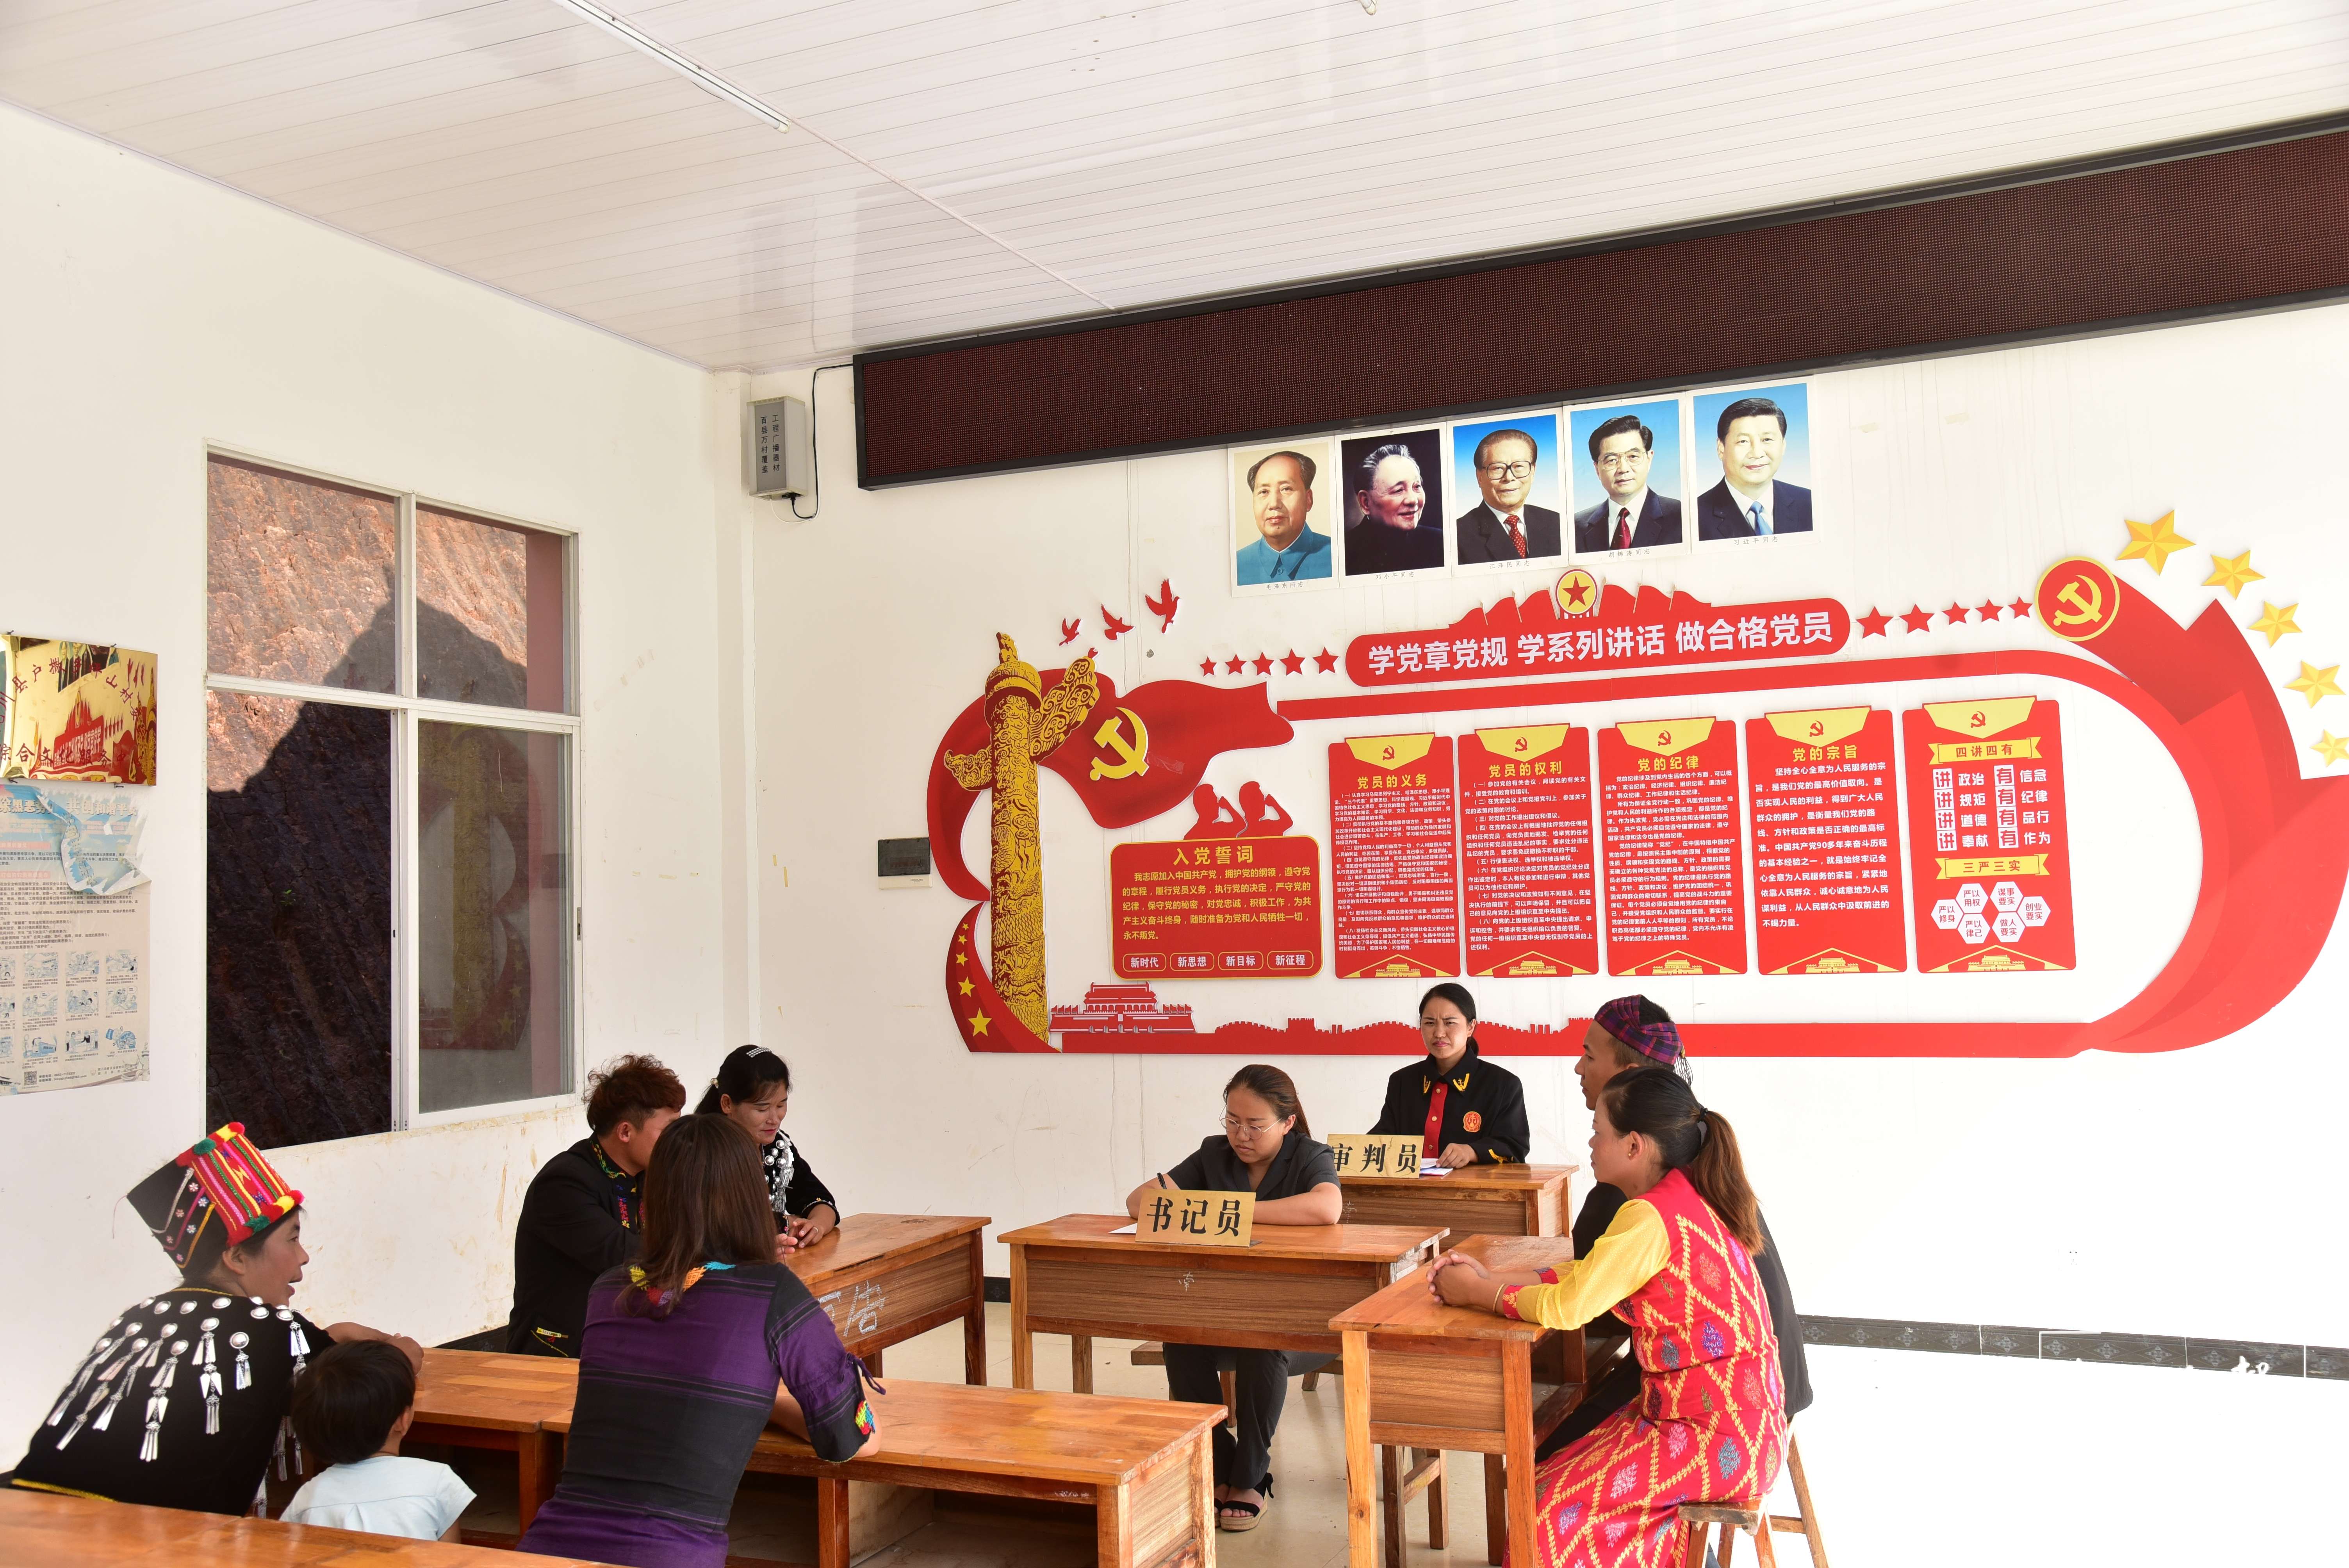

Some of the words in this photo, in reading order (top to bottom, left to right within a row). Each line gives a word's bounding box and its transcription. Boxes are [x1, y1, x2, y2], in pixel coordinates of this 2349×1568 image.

[1734, 536, 1778, 545] 习近平同志
[1609, 549, 1650, 558] 胡锦涛同志
[1489, 561, 1530, 569] 江泽民同志
[1375, 571, 1415, 581] 邓小平同志
[1266, 582, 1304, 590] 毛泽东同志
[1369, 637, 1507, 675] 学党章党规
[1518, 625, 1665, 665] 学系列讲话
[1675, 613, 1833, 652] 做合格党员
[1793, 743, 1857, 762] 党的宗旨
[1956, 744, 2013, 757] 四讲四有
[1489, 760, 1564, 779] 党员的权利
[1638, 754, 1698, 772] 党的纪律
[1775, 761, 1886, 776] 坚持全心全意为人民服务的宗
[1358, 773, 1427, 790] 党员的义务
[1755, 777, 1882, 792] 旨，是我们党的最高价值取向。是
[1934, 769, 1950, 787] 讲
[1958, 773, 1984, 786] 政治
[1997, 768, 2012, 783] 有
[2020, 769, 2046, 782] 信念
[1464, 788, 1529, 797] 件，接受党的教育和培训。
[1937, 792, 1952, 807] 讲
[1960, 793, 1985, 806] 规矩
[1998, 789, 2013, 804] 有
[2021, 790, 2048, 803] 纪律
[1756, 793, 1883, 807] 否实现人民的利益，得到广大人民
[1465, 806, 1518, 814] 党的政策问题的讨论。
[1756, 808, 1875, 822] 群众的拥护，是衡量我们党的路
[1938, 813, 1953, 828] 讲
[1961, 814, 1987, 827] 道德
[2000, 810, 2014, 825] 有
[2023, 811, 2049, 824] 品行
[1757, 823, 1885, 837] 线、方针和政策是否正确的最高标
[1758, 838, 1887, 852] 准。中国共产党90多年来奋斗历程
[1940, 833, 1954, 848] 讲
[1962, 834, 1988, 847] 奉献
[2001, 830, 2016, 845] 有
[2024, 832, 2050, 845] 作为
[1173, 846, 1253, 865] 入党誓词
[1759, 853, 1886, 867] 的基本经验之一，就是始终牢记全
[1134, 866, 1310, 881] 我志愿加入中国共产党，拥护党的纲领，遵守党
[1963, 860, 2021, 873] 三严三实
[1760, 869, 1887, 882] 心全意为人民服务的宗旨，紧紧地
[1122, 881, 1311, 896] 的章程，履行党员义务，执行党的决定，严守党的
[1760, 885, 1889, 897] 依靠人民群众，诚心诚意地为人民
[1123, 896, 1311, 911] 纪律，保守党的秘密，对党忠诚，积极工作，为共
[1761, 900, 1889, 912] 谋利益，从人民群众中汲取前进的
[1123, 912, 1308, 925] 产主义奋斗终身，随时准备为党和人民牺牲一切，
[1763, 918, 1799, 927] 不竭力量。
[1123, 930, 1158, 940] 永不叛党。
[1131, 957, 1158, 968] 新时代
[1178, 956, 1206, 967] 新思想
[1226, 955, 1255, 966] 新目标
[1276, 955, 1305, 966] 新征程
[1332, 1143, 1417, 1173] 审判员
[1147, 1197, 1240, 1236] 书记员
